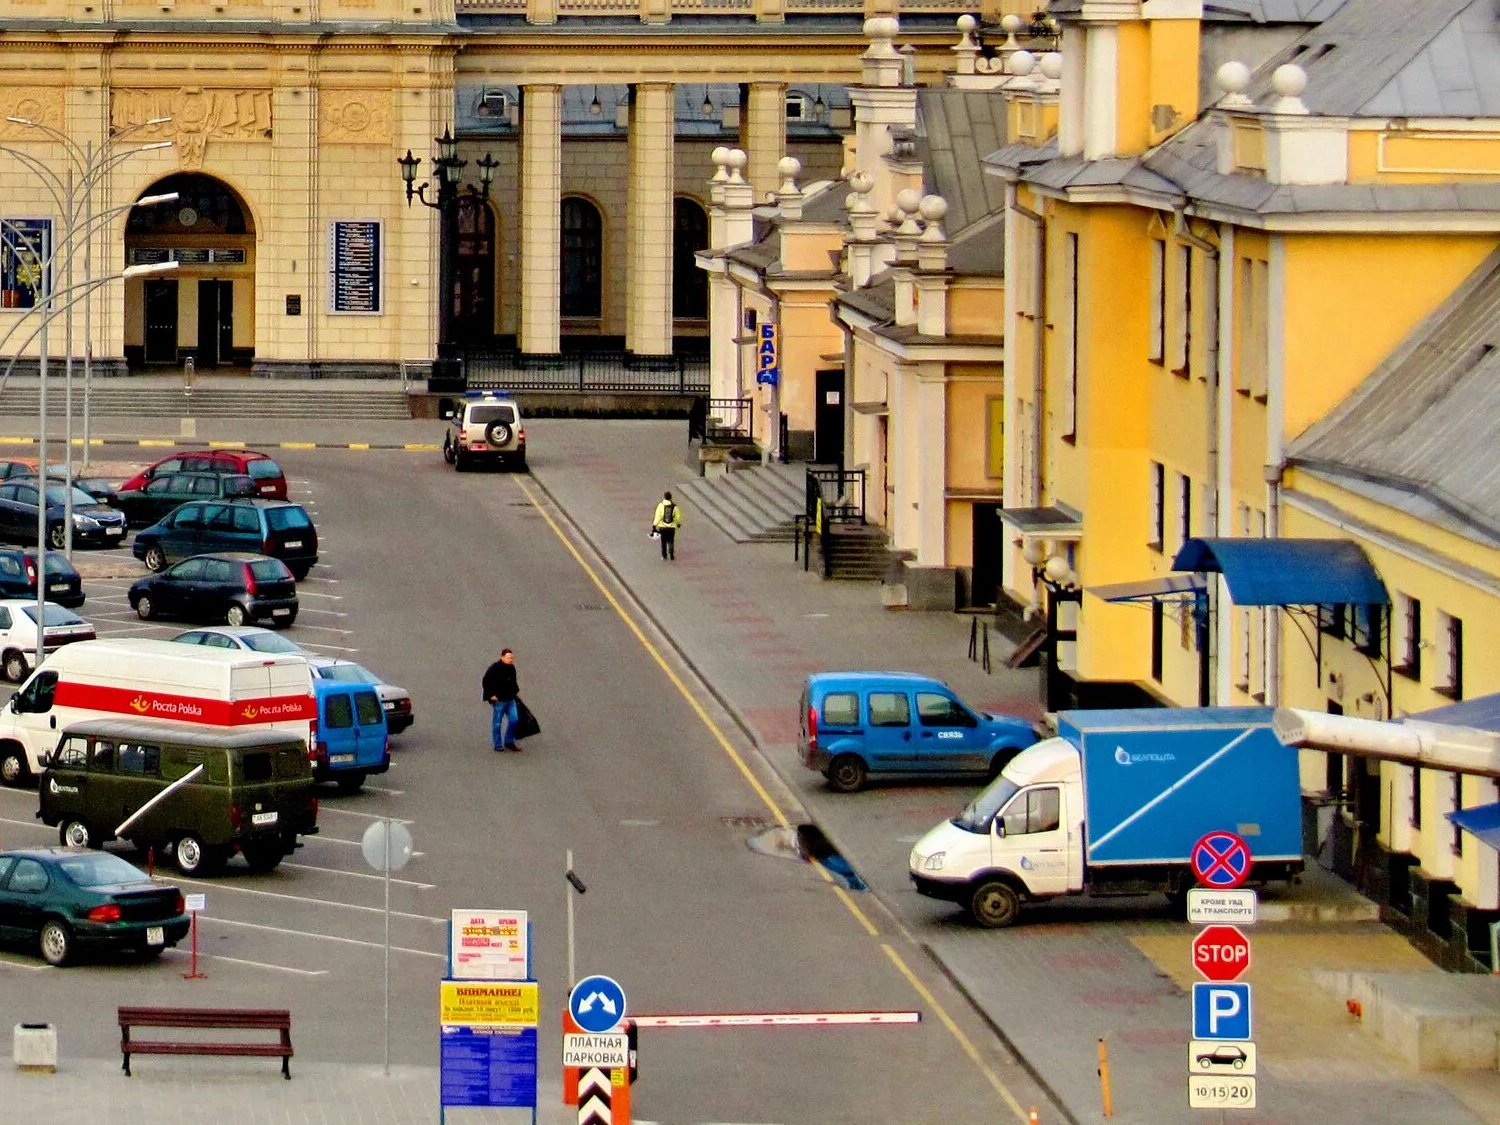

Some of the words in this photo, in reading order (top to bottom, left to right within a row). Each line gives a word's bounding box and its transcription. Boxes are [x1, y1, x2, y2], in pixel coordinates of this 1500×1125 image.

[760, 325, 775, 369] БАР
[152, 700, 177, 714] Poczta
[178, 704, 203, 716] Polska
[259, 705, 281, 715] Poczta
[282, 703, 303, 713] Polska
[1201, 898, 1226, 906] КРОМЕ
[1204, 907, 1252, 915] ТРАНСПОРТЕ
[1197, 944, 1247, 963] STOP
[1209, 989, 1240, 1034] P
[570, 1036, 622, 1048] ПЛАТНАЯ
[565, 1052, 624, 1063] ПАРКОВКА
[1195, 1087, 1208, 1097] 10
[1210, 1087, 1227, 1098] 15
[1230, 1086, 1249, 1098] 20
